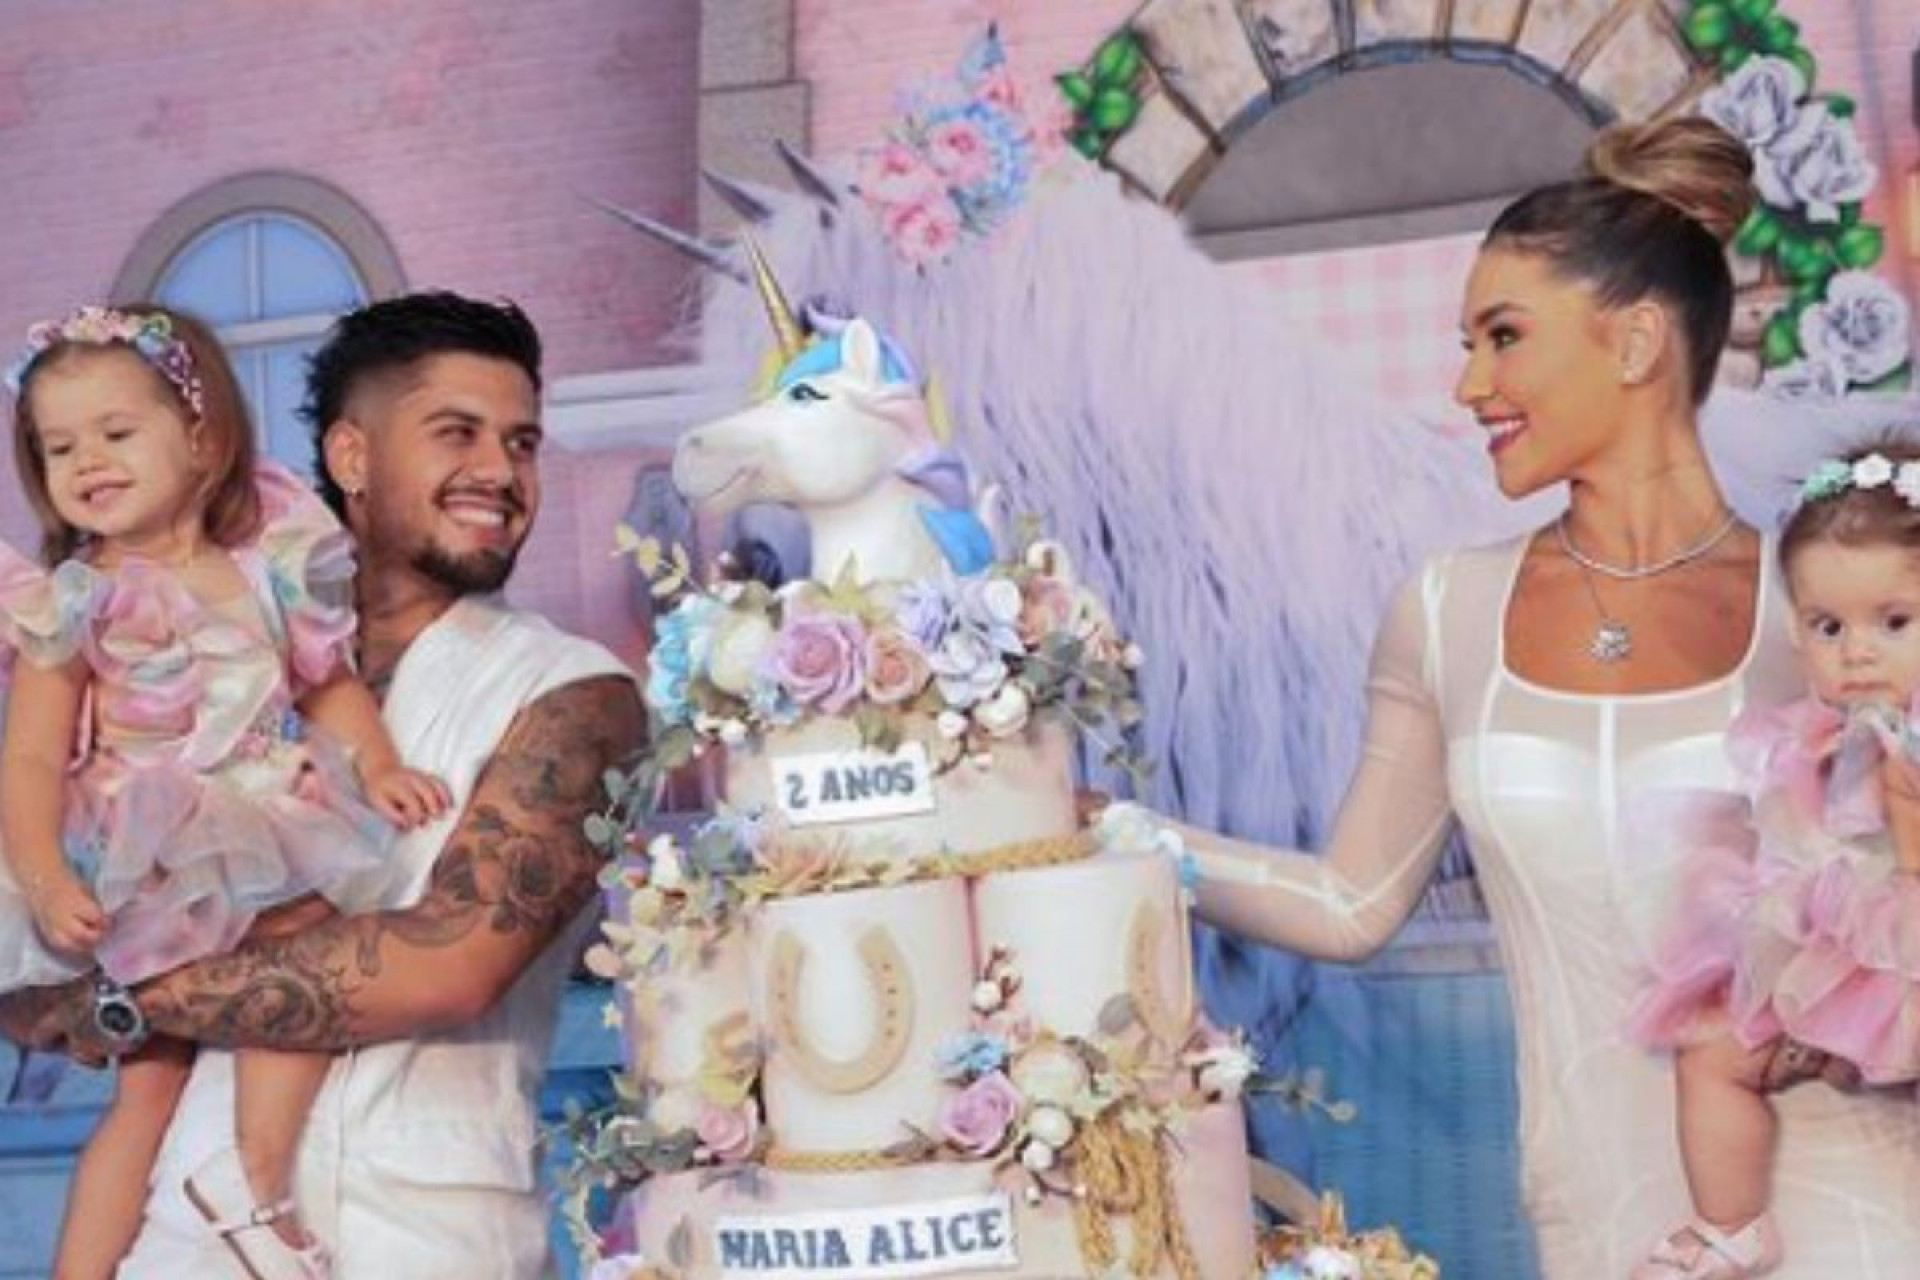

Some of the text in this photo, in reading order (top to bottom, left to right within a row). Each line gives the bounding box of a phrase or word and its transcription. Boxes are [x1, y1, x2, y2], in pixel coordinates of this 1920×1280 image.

[786, 760, 915, 809] 2 ANOS
[719, 1207, 1003, 1269] MARIA ALICE
